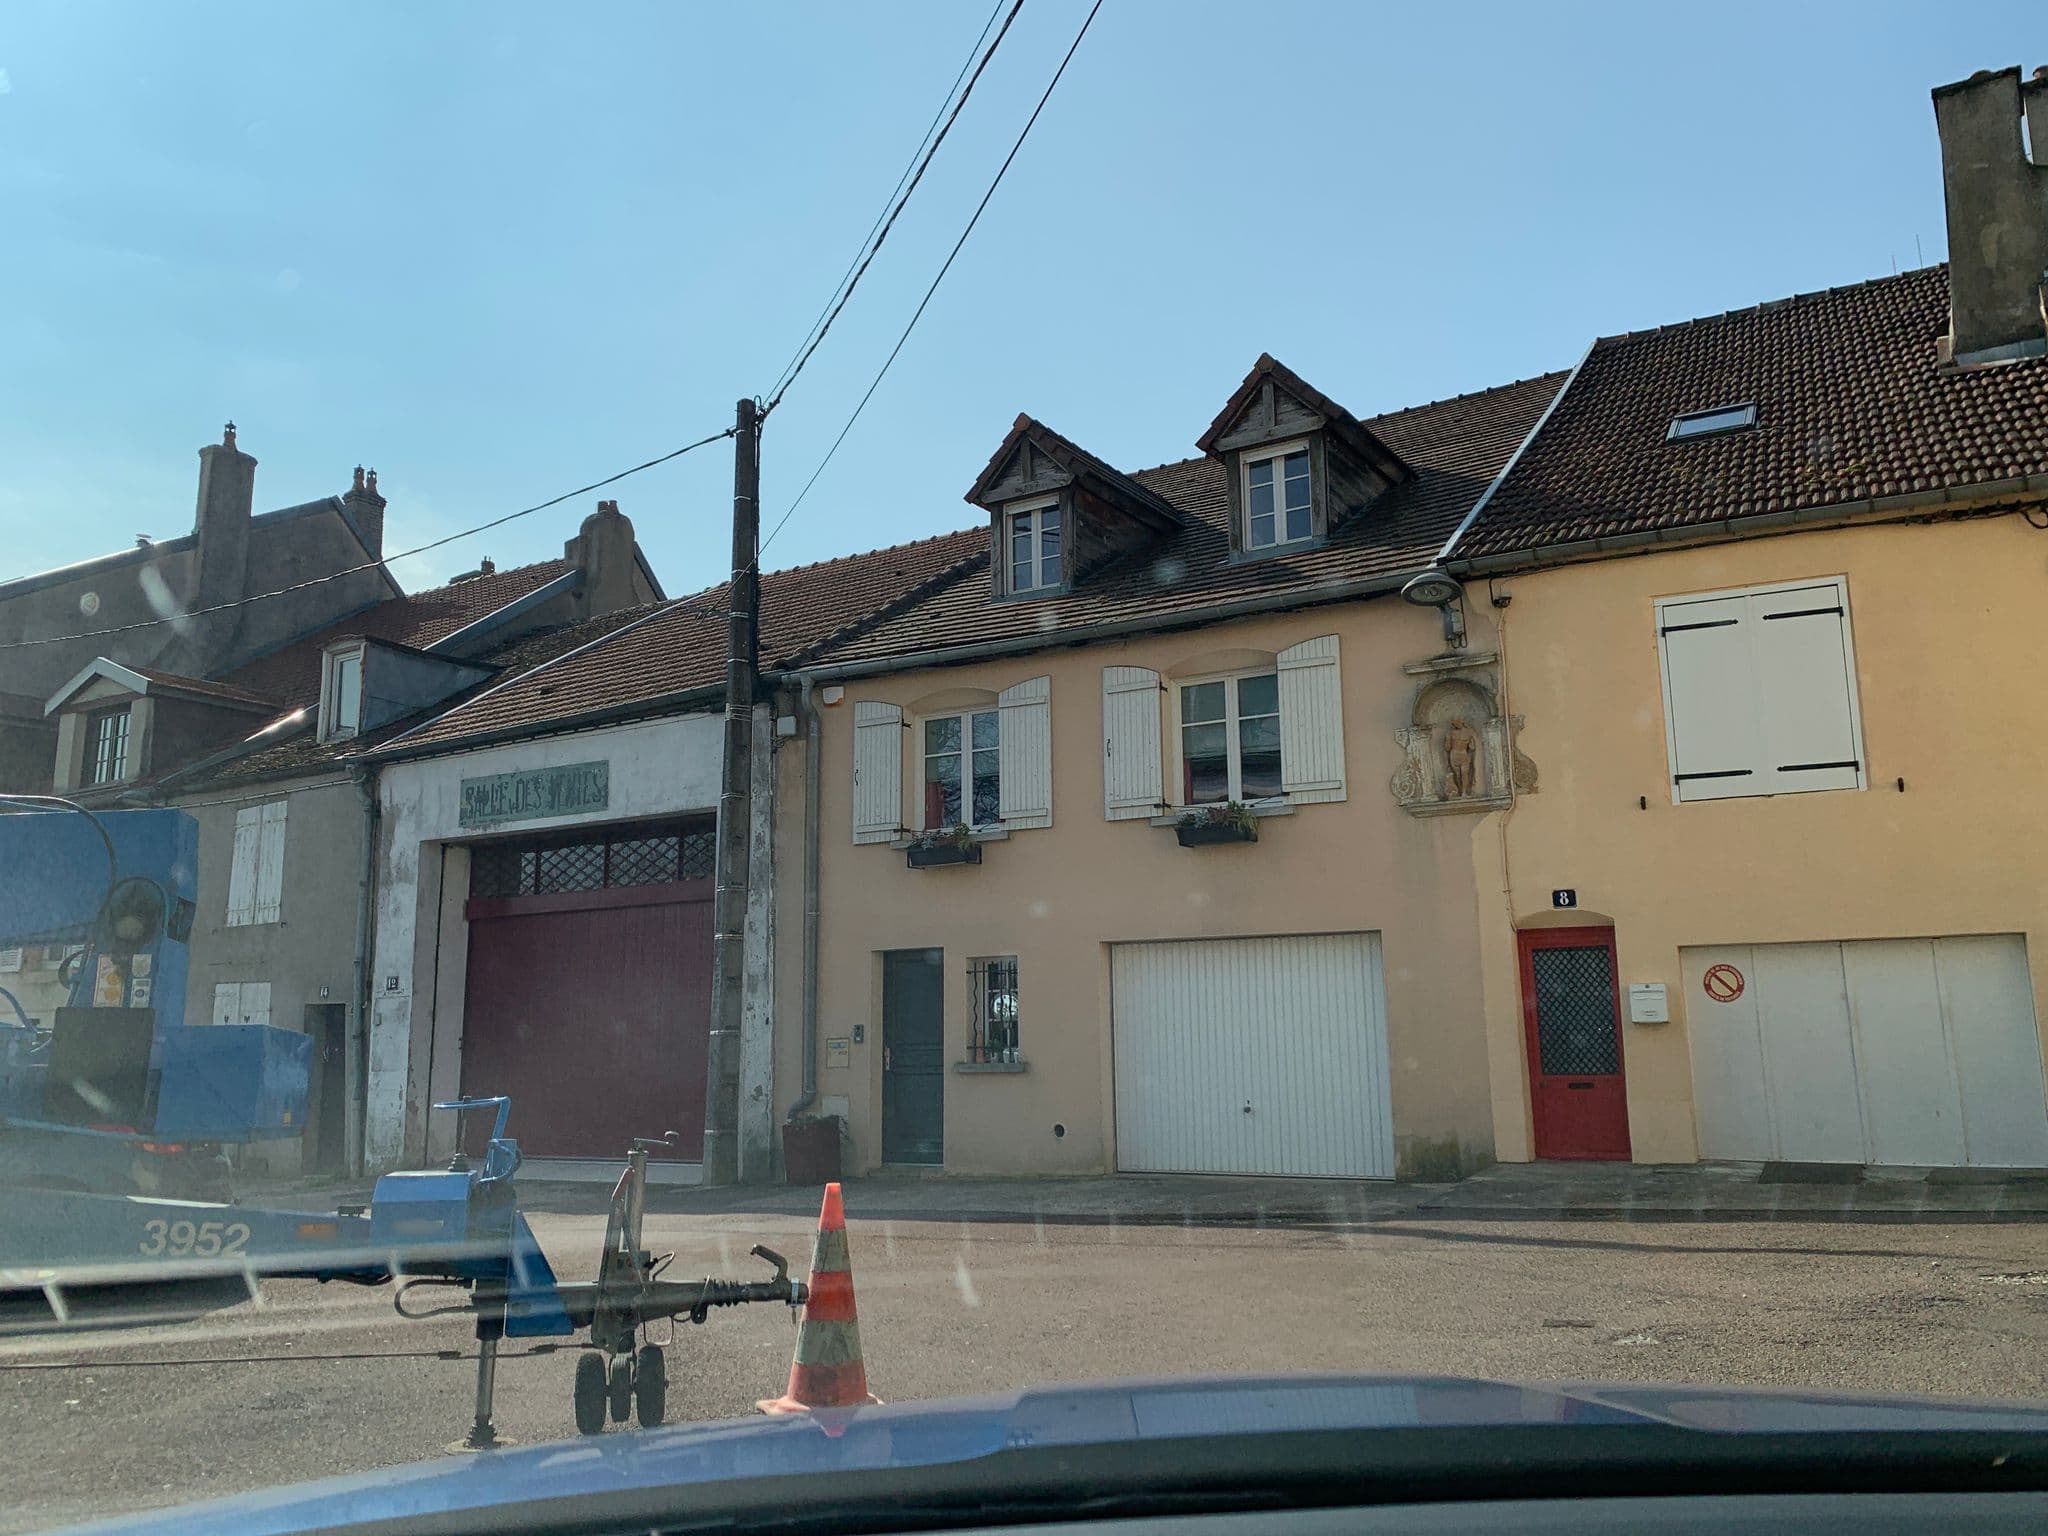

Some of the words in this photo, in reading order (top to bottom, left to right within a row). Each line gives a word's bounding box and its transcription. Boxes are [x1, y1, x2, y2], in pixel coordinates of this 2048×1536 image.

[513, 776, 542, 813] DES
[1559, 891, 1569, 905] 8
[139, 1219, 251, 1258] 3952
